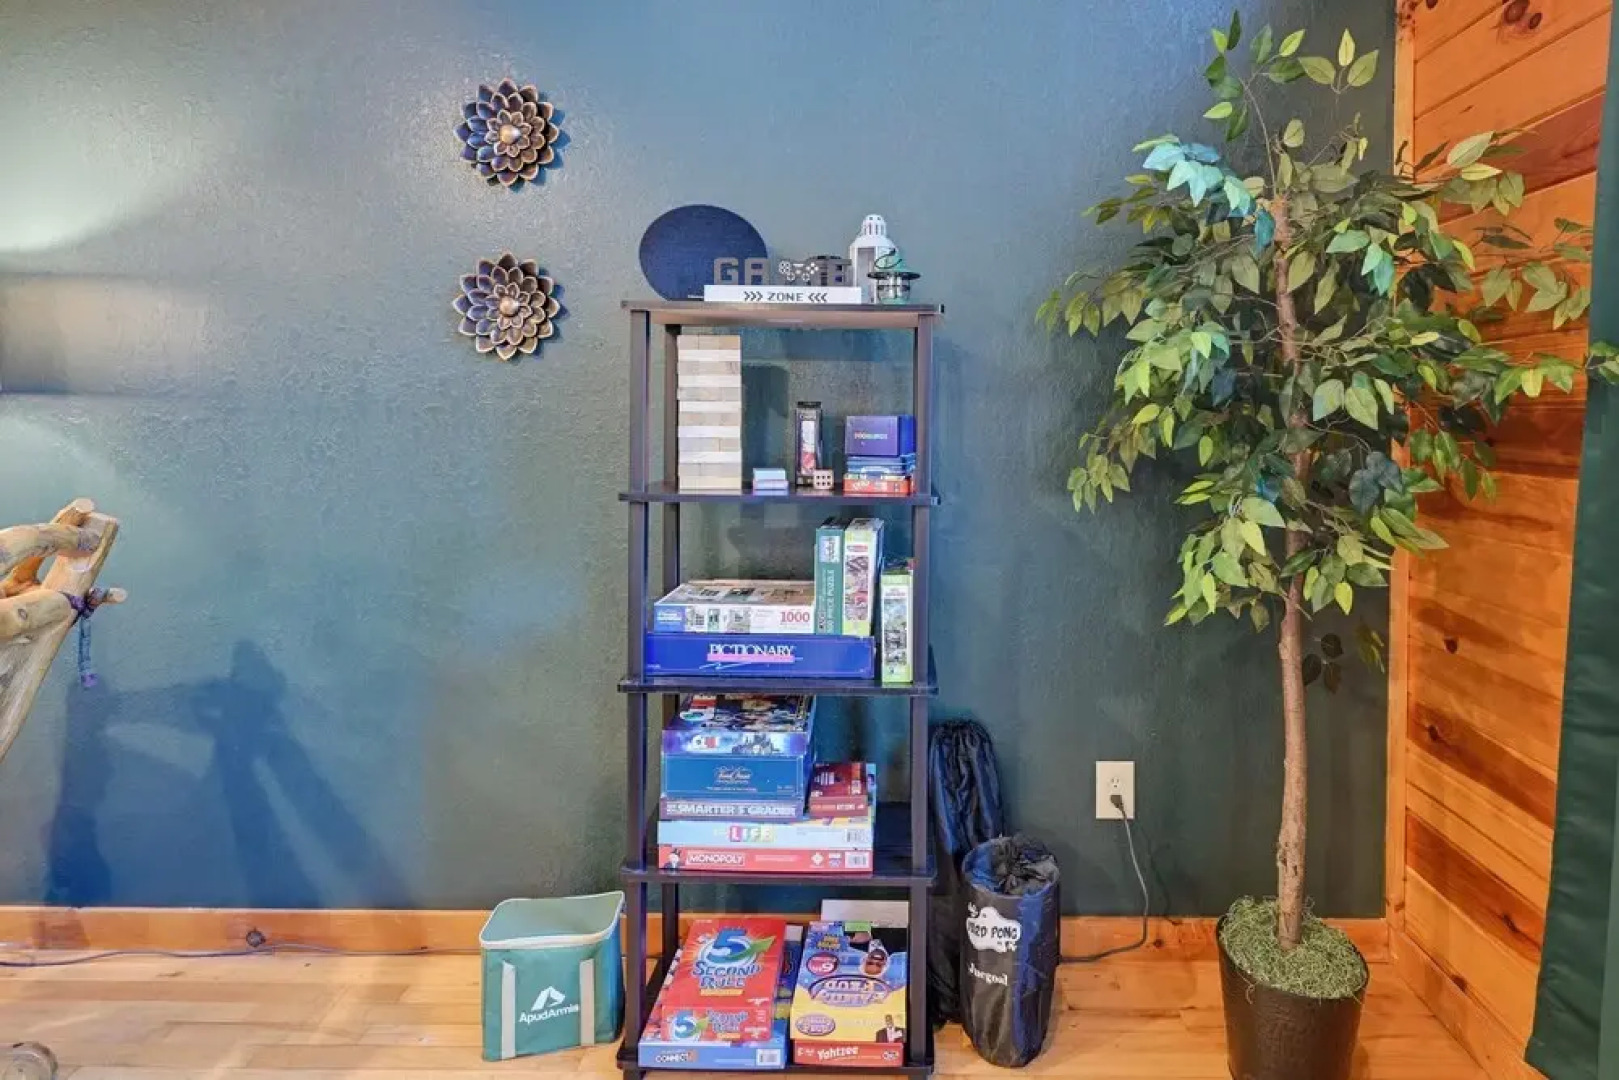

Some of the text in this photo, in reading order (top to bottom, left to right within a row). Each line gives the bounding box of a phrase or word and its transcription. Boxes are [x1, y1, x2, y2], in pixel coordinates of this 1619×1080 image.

[767, 292, 804, 302] ZONE
[780, 611, 811, 623] 1000
[709, 643, 794, 656] PICTIONARY
[730, 826, 773, 842] LIFE
[689, 854, 743, 864] MONOPOLY
[991, 925, 1018, 940] PONG
[707, 928, 750, 963] 5
[692, 960, 760, 976] SECOND
[700, 976, 746, 988] RULE
[674, 1010, 697, 1038] 5
[817, 1046, 859, 1060] Yahtzee
